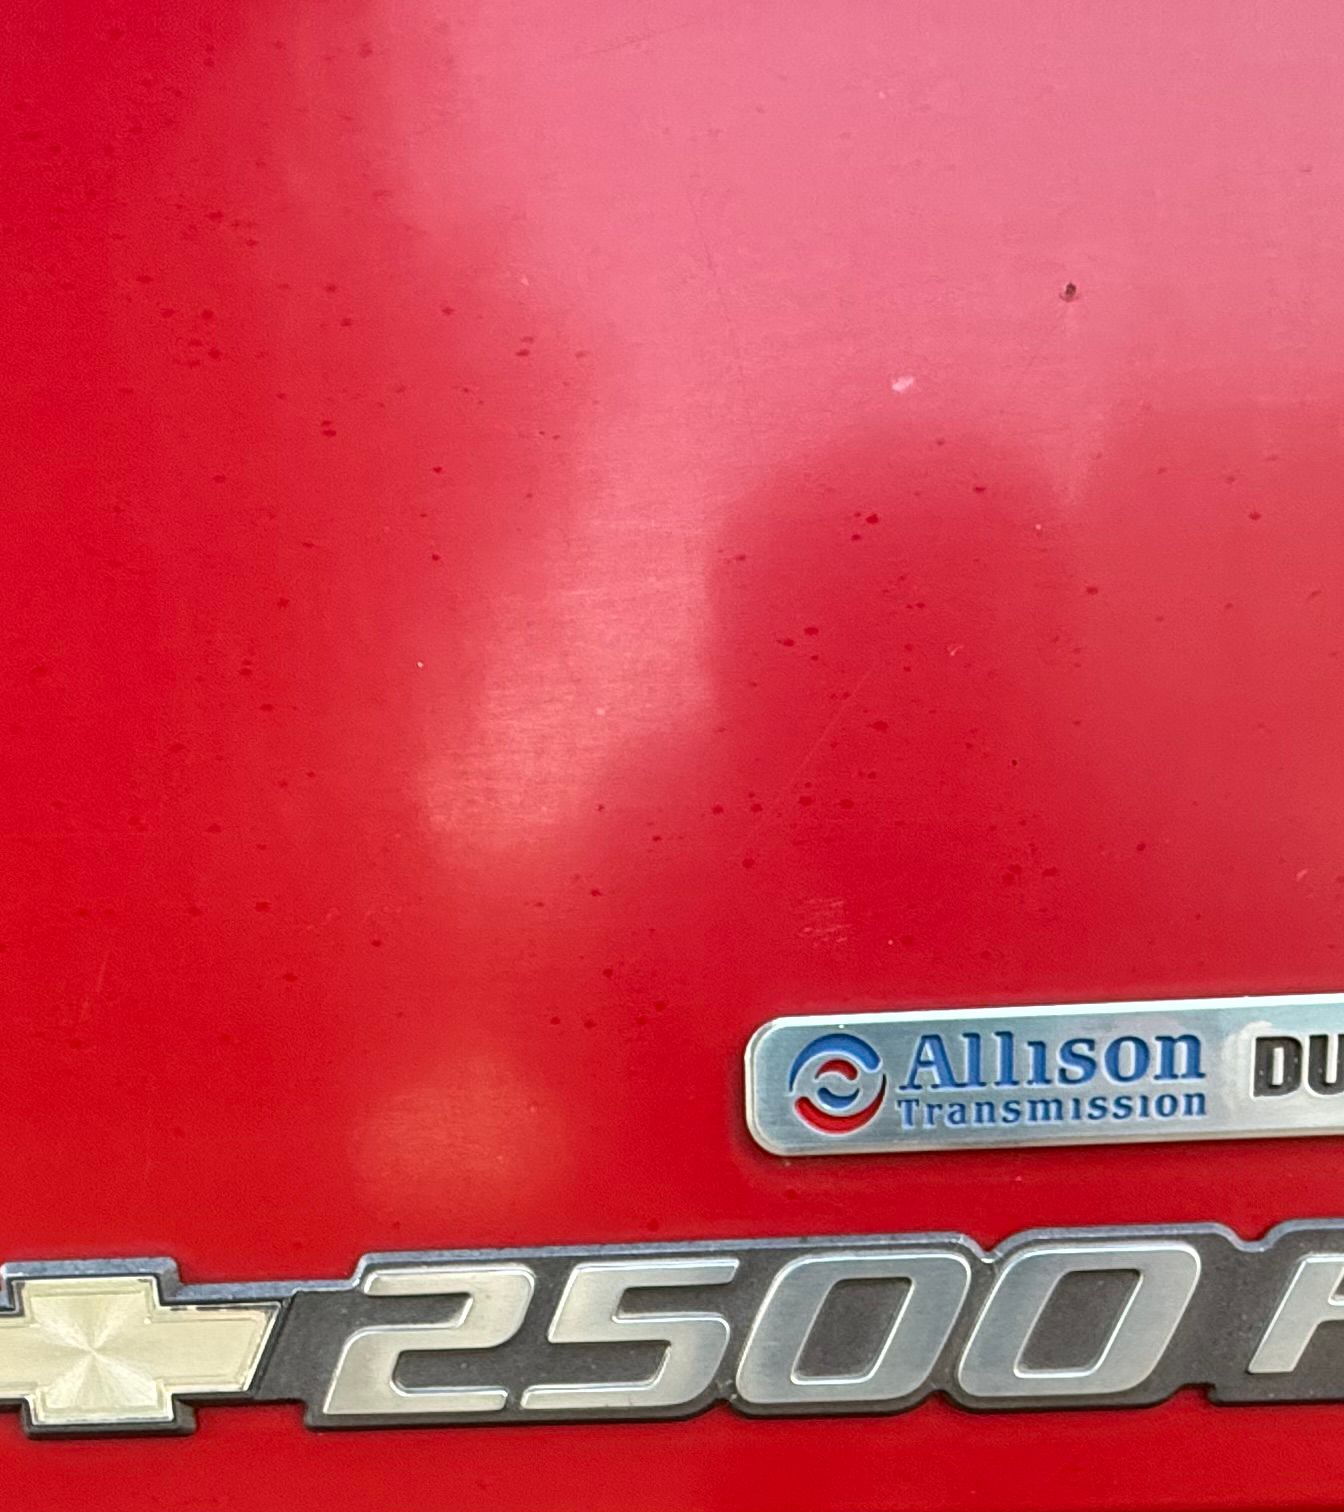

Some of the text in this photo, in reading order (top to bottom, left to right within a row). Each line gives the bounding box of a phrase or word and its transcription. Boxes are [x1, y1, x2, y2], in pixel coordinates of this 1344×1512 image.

[898, 1029, 1207, 1092] Allison
[897, 1091, 1208, 1129] Transmission
[323, 1240, 1202, 1415] 2500
